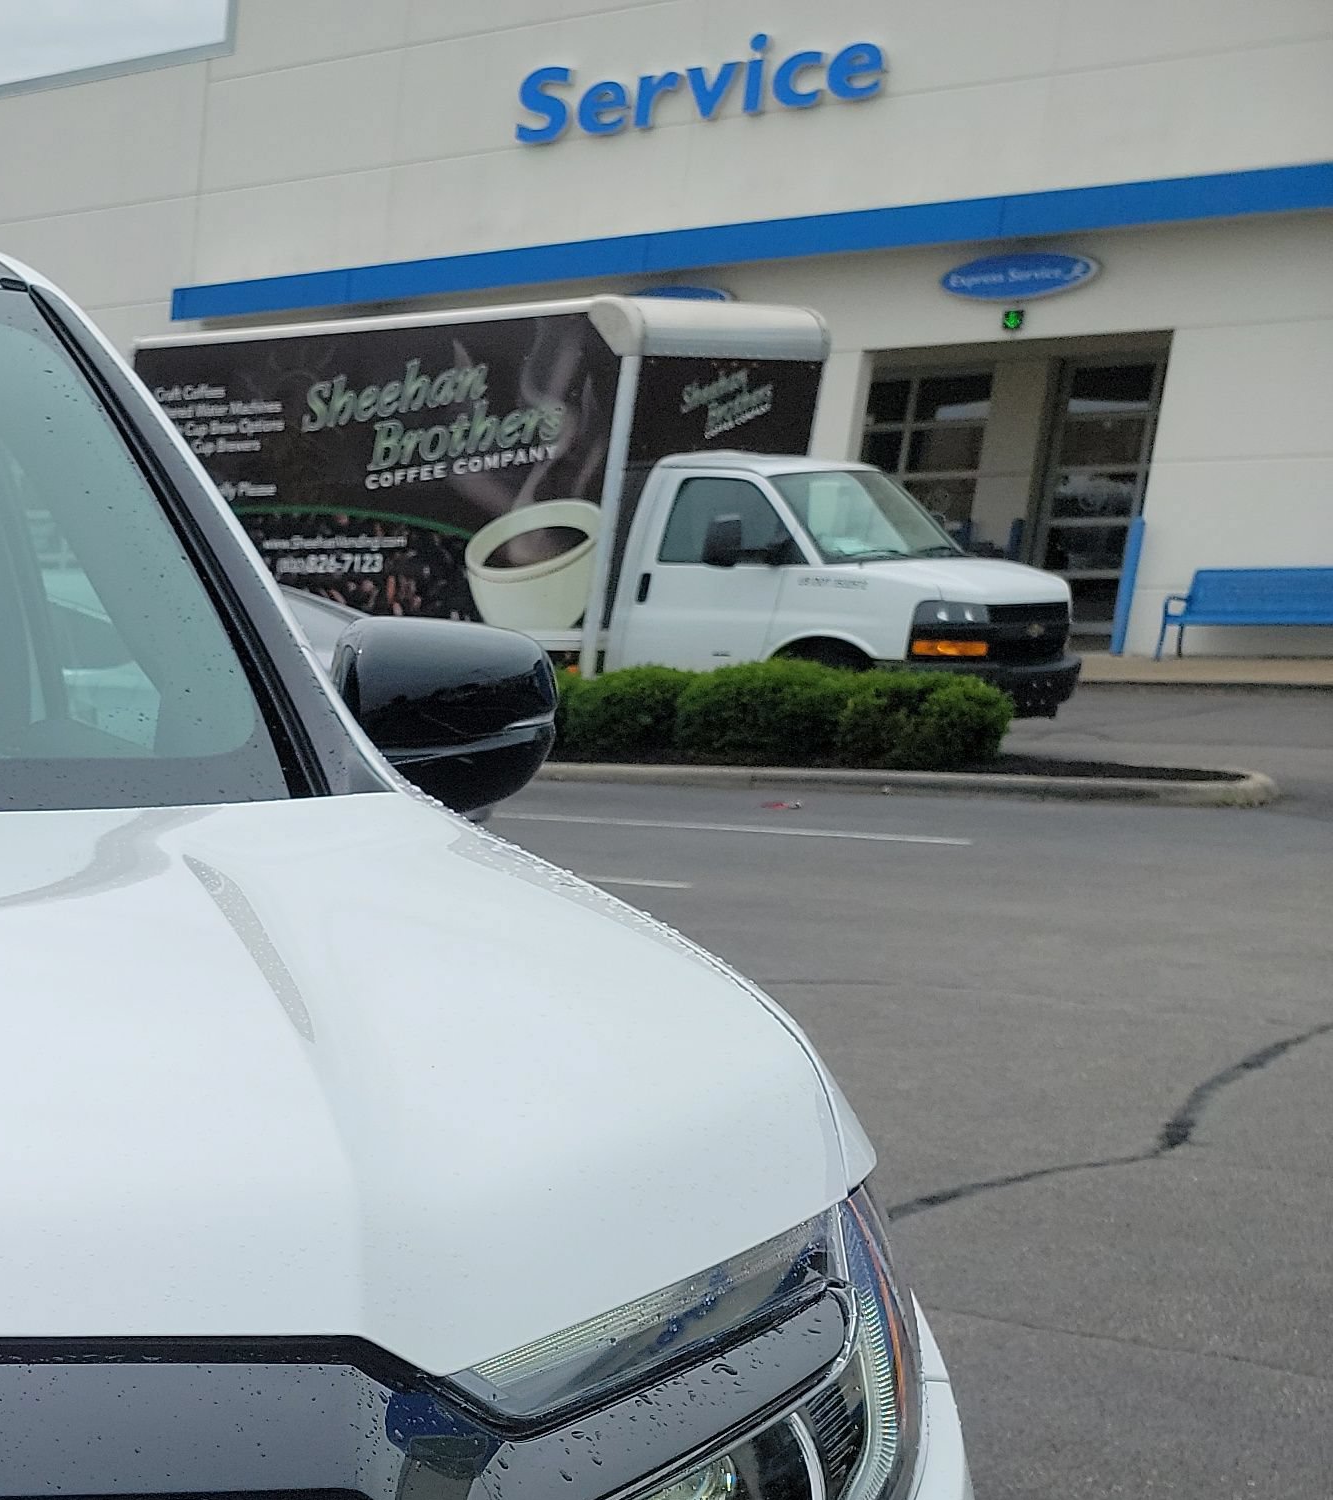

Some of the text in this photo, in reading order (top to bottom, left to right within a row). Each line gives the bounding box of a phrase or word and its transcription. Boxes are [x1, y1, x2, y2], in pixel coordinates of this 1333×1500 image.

[515, 33, 885, 145] Service
[301, 358, 488, 433] Sheehan
[364, 445, 557, 490] COFFEE COMPANY
[366, 399, 567, 471] Brothers
